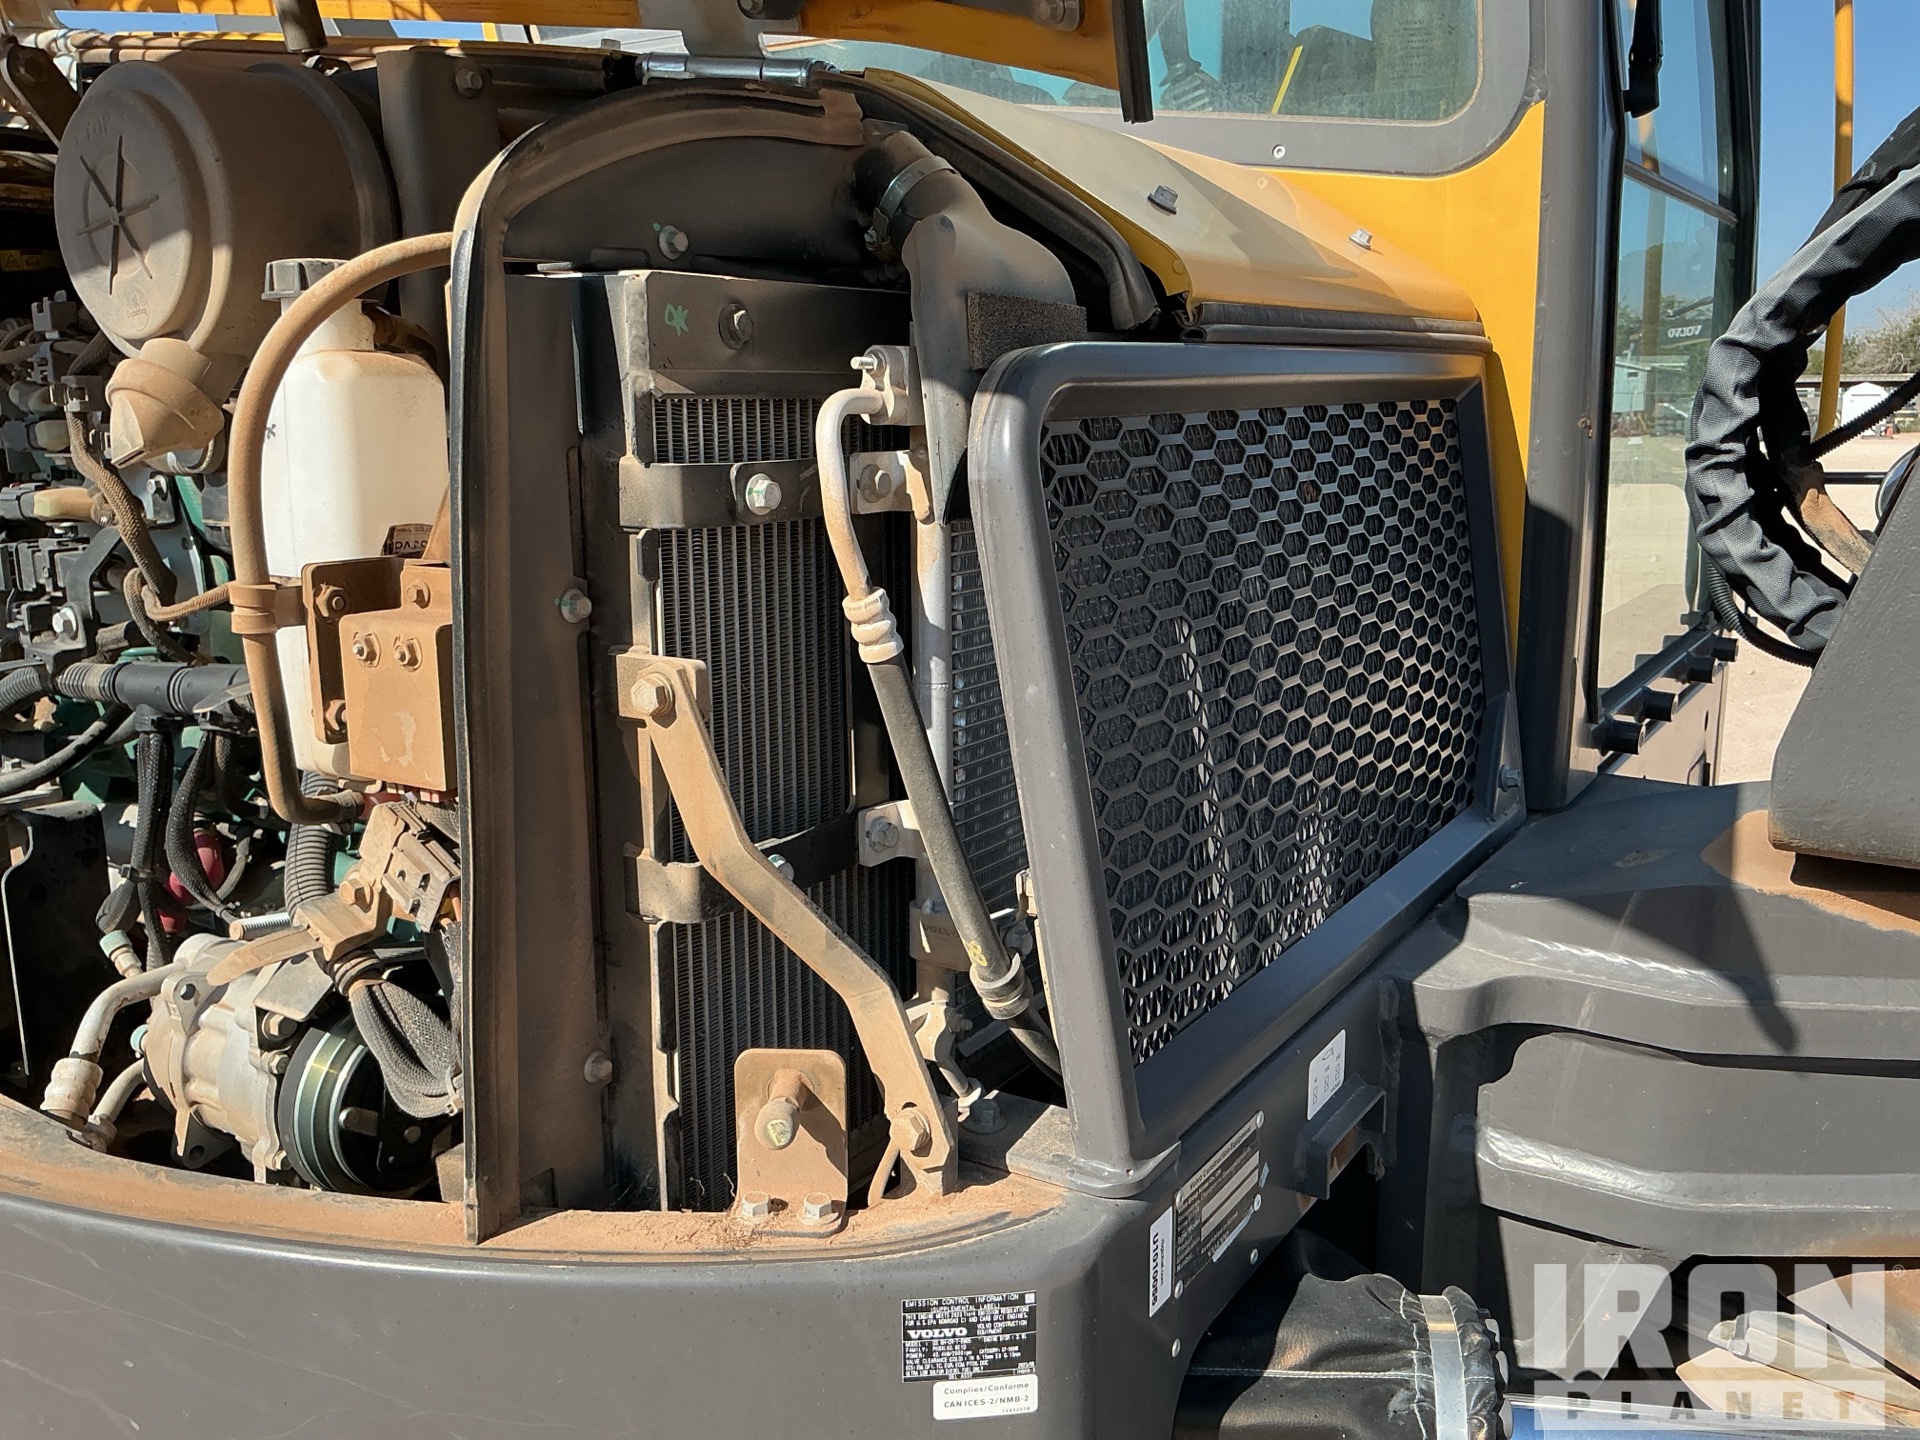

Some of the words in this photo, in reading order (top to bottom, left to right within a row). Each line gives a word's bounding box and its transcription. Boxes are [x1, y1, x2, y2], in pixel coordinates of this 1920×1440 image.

[942, 1297, 969, 1305] CONTROL
[975, 1293, 1018, 1302] INFORMATION
[907, 1327, 967, 1338] VOLVO
[944, 1383, 1029, 1394] Complies/Conforme
